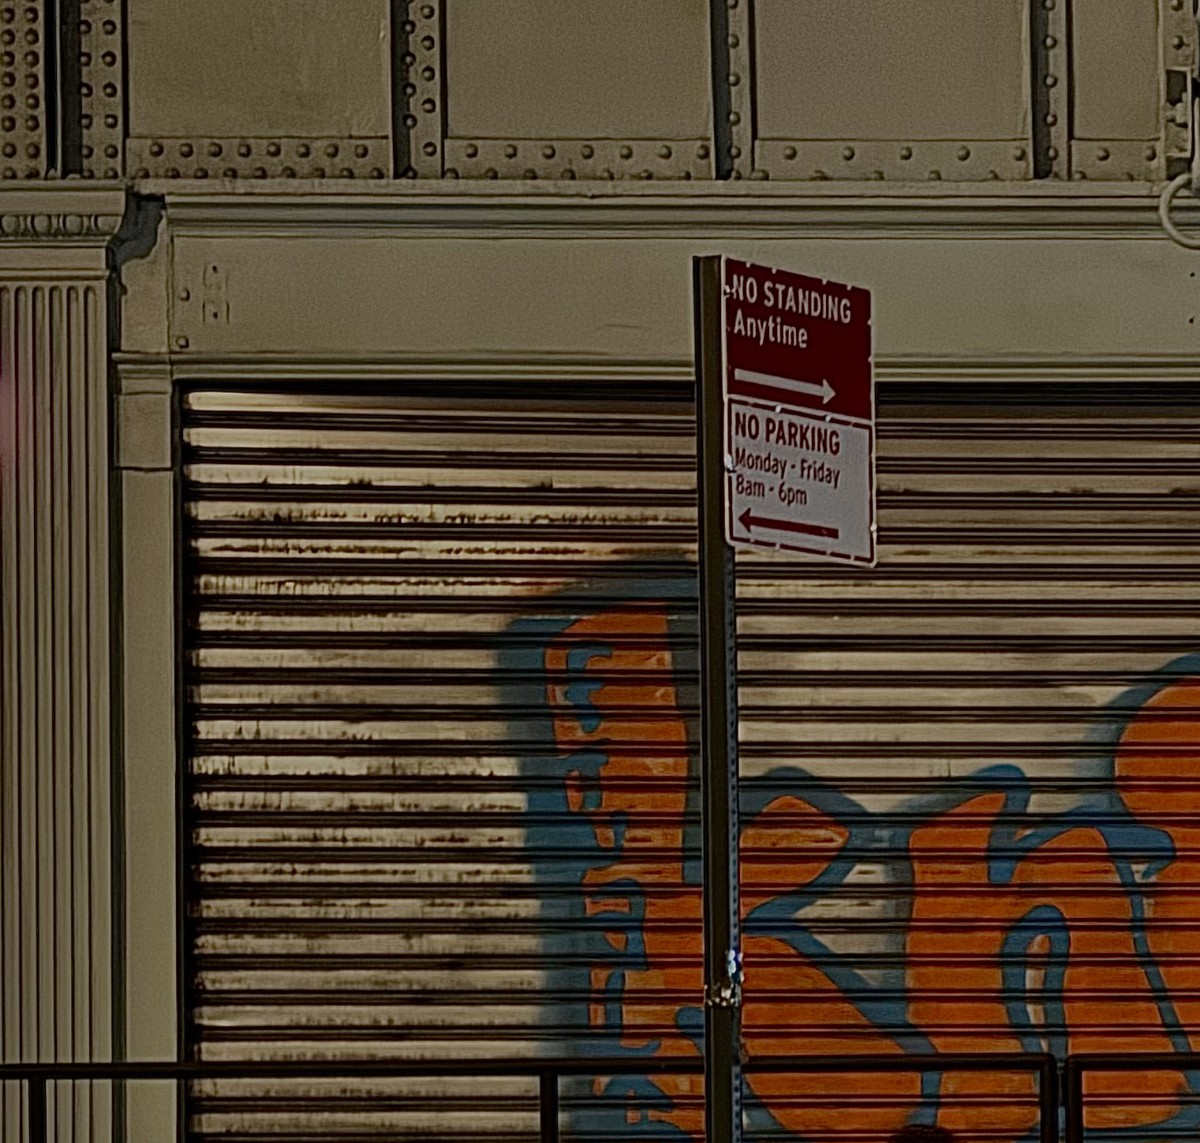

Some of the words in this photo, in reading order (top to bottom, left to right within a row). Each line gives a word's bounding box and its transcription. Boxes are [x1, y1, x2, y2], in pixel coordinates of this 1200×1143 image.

[732, 273, 758, 301] NO
[763, 280, 851, 324] STANDING
[733, 308, 808, 348] Anytime
[735, 412, 759, 439] NO
[765, 417, 840, 455] PARKING
[734, 449, 787, 478] Monday
[800, 458, 840, 489] Friday
[736, 474, 765, 498] 8am
[778, 480, 807, 506] 6pm
